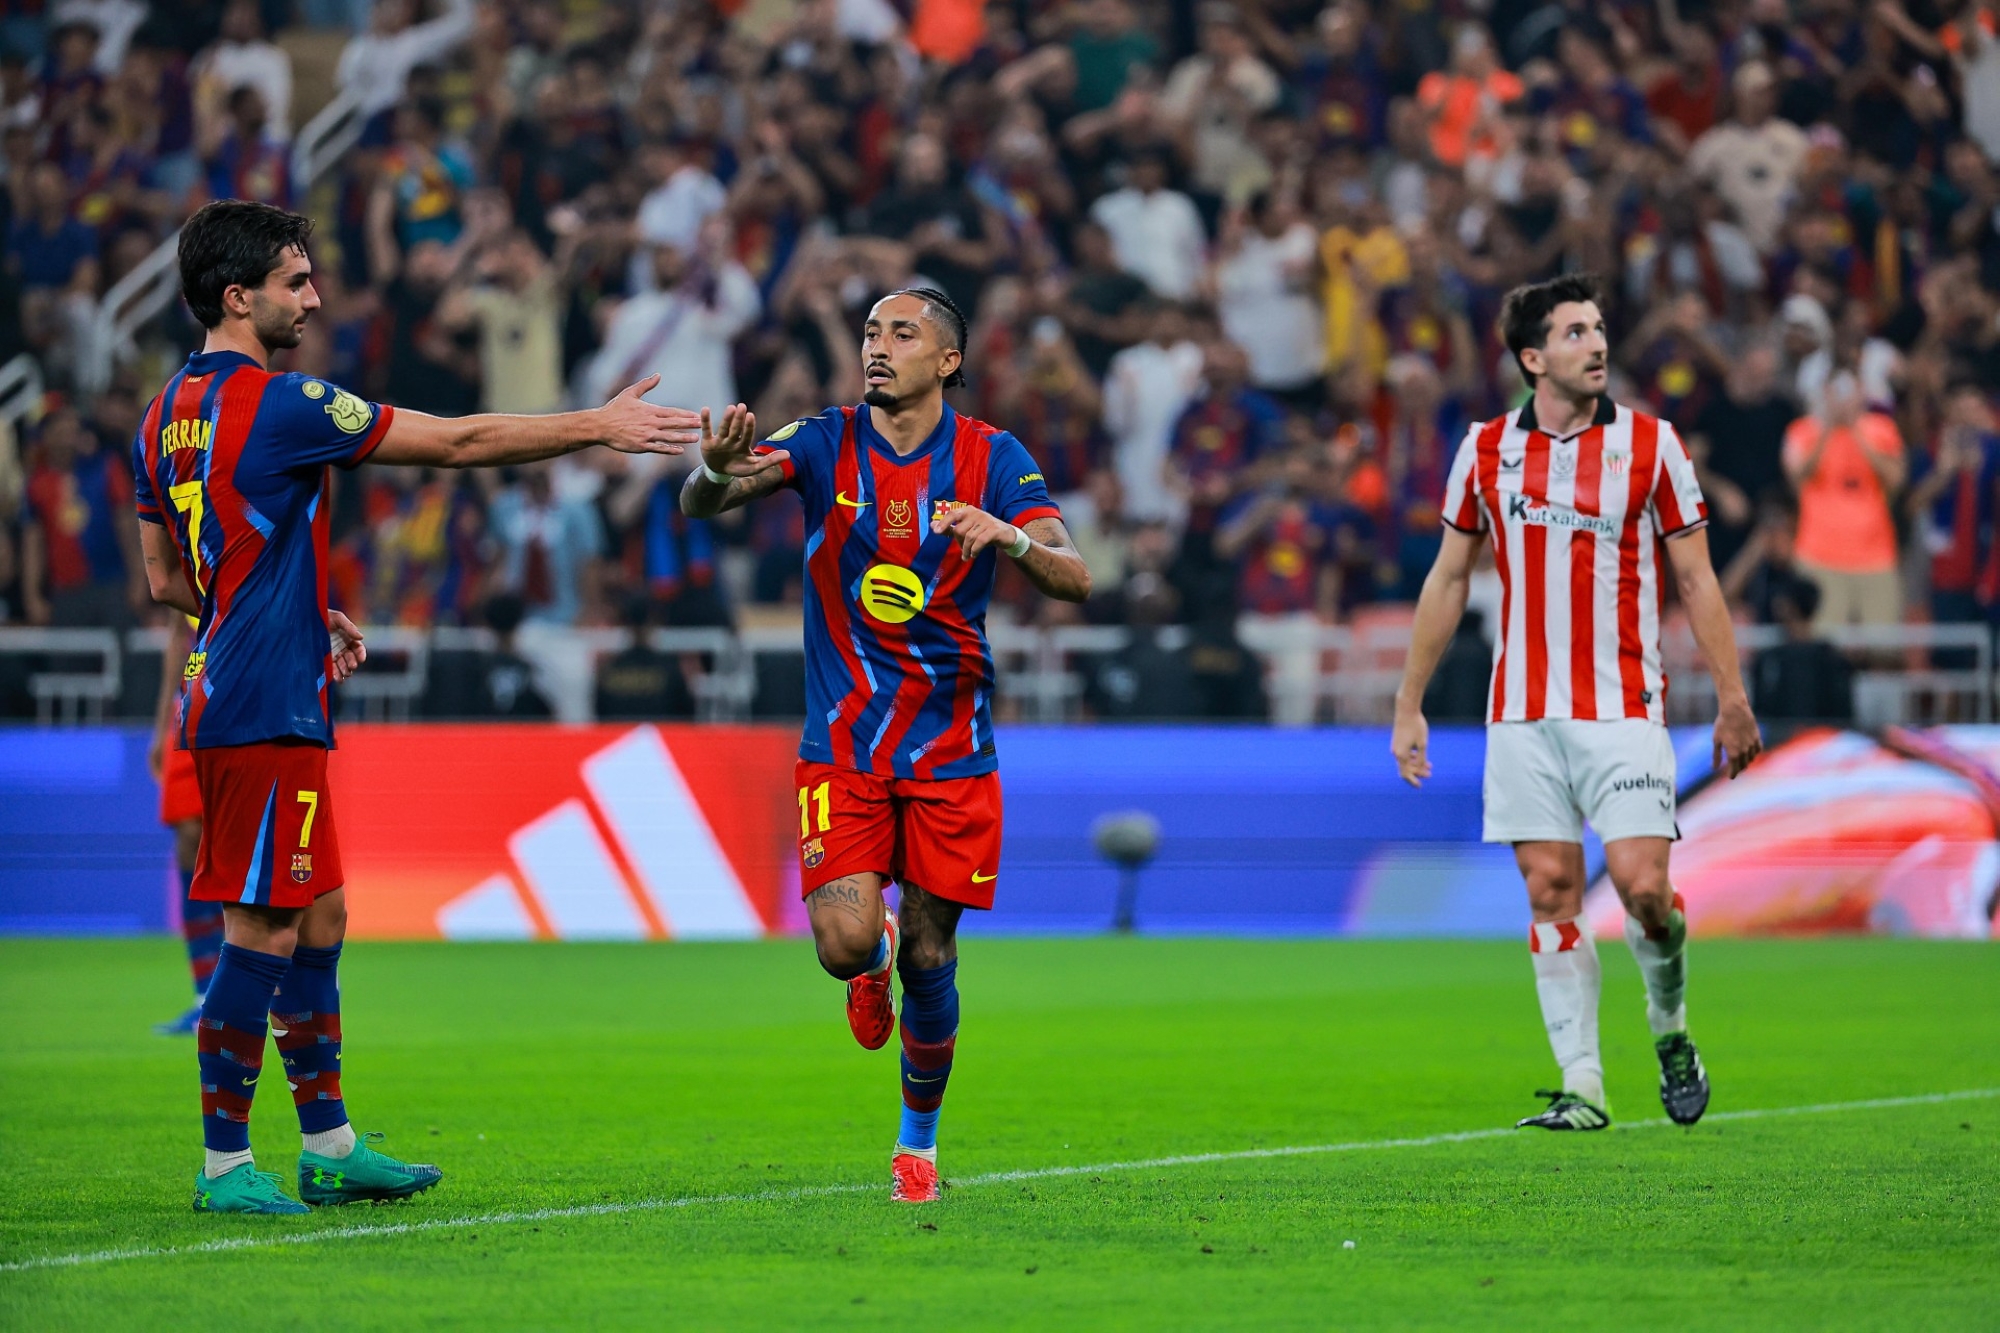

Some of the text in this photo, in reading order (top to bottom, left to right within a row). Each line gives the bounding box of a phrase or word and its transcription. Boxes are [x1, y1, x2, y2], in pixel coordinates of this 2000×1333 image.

[161, 418, 213, 458] FERRAN
[1509, 491, 1615, 535] Kutxabank
[168, 480, 206, 598] 7
[1613, 772, 1671, 796] vueling
[296, 790, 318, 848] 7
[798, 781, 831, 840] 11
